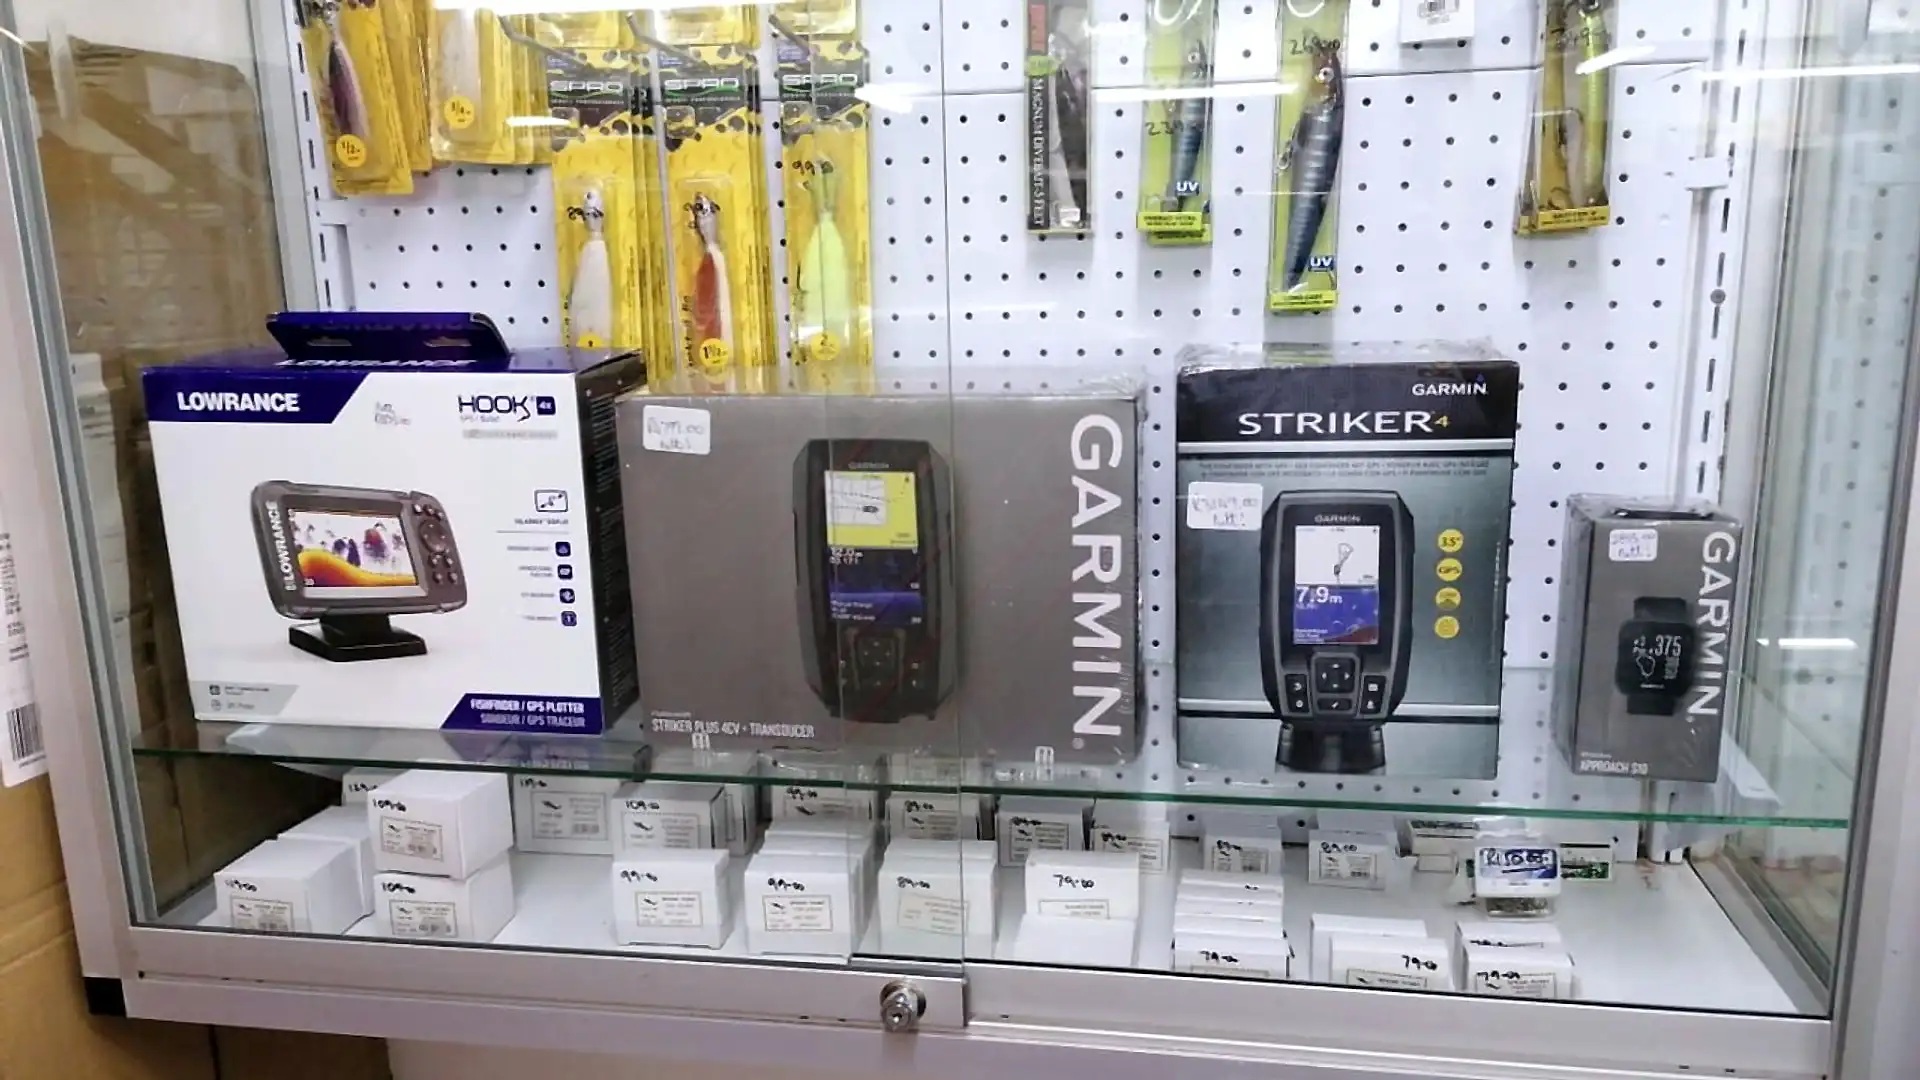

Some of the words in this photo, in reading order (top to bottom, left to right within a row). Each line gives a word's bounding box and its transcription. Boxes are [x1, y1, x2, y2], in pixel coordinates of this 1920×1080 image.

[1176, 180, 1199, 192] UV
[1310, 256, 1332, 267] UV
[1412, 383, 1488, 396] GARMIN
[177, 391, 300, 413] LOWRANCE
[1238, 411, 1433, 435] STRIKER
[1314, 514, 1361, 523] GARMIN
[265, 500, 296, 582] LOWRANCE
[1070, 414, 1124, 737] GARMIN
[1686, 531, 1737, 717] GARMIN
[1655, 634, 1682, 657] 375
[652, 718, 693, 732] STRIKER
[694, 720, 720, 734] PLUS
[749, 722, 815, 738] TRANSDUCER
